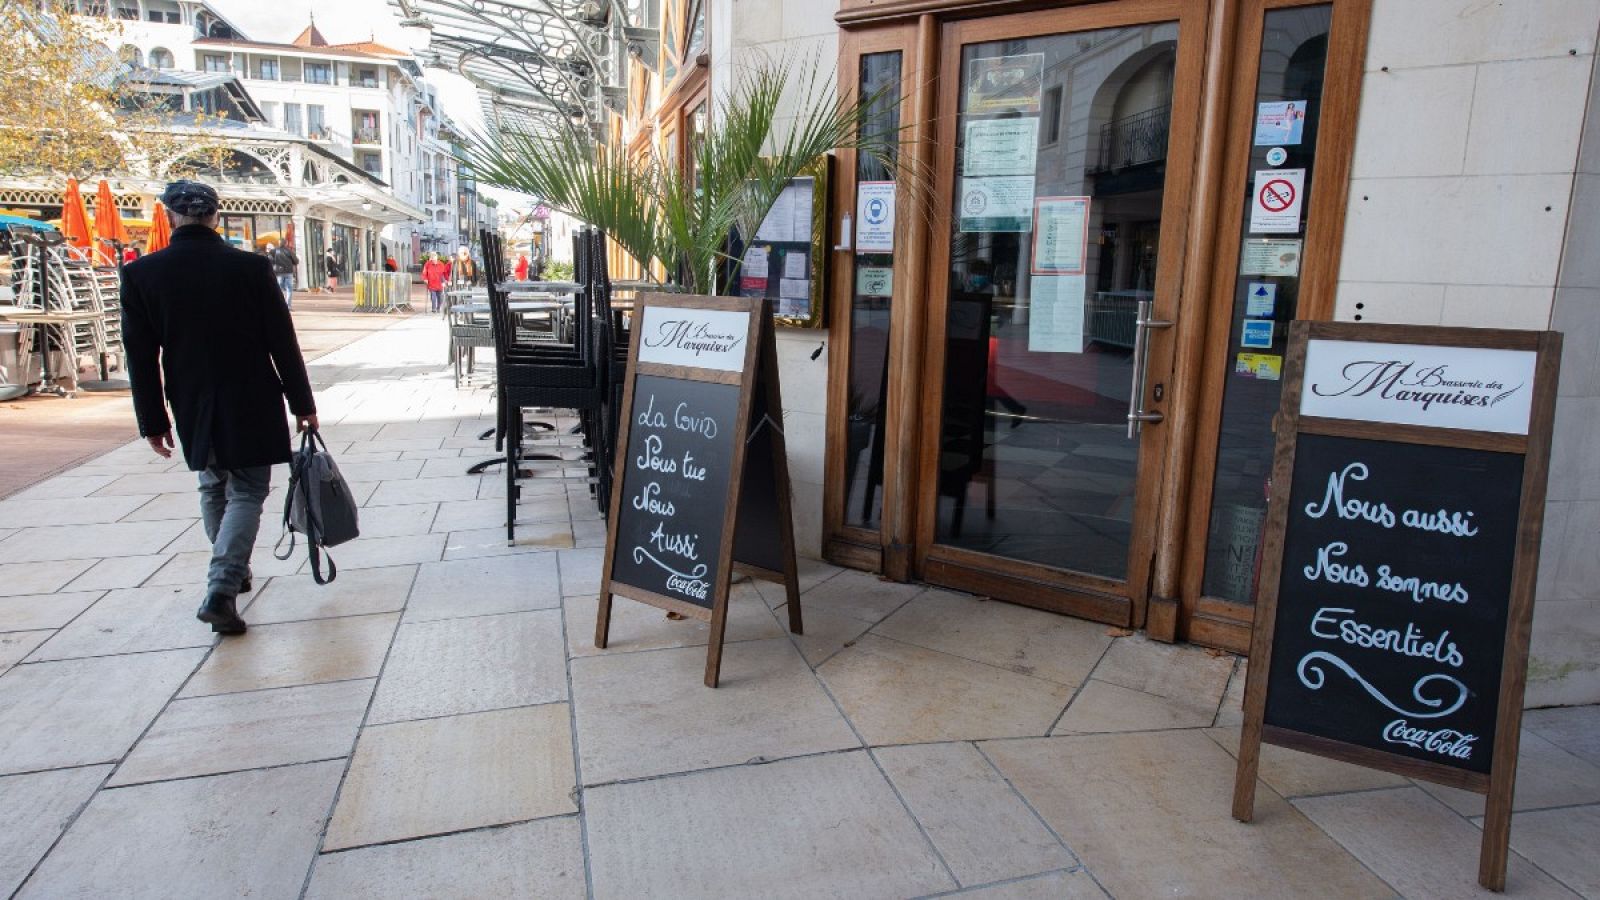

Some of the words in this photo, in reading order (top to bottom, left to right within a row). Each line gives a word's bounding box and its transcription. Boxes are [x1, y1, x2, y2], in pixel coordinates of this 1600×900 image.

[644, 320, 729, 357] Marquises
[1312, 360, 1489, 411] Marquises
[1400, 365, 1481, 389] Brasserie
[1485, 380, 1503, 390] des
[682, 450, 707, 481] tue
[632, 482, 676, 517] Nous
[1304, 462, 1396, 529] Nous
[1402, 508, 1479, 537] aussi
[649, 521, 699, 561] Aussi
[1303, 541, 1369, 588] Nous
[1310, 607, 1464, 668] Essentiels
